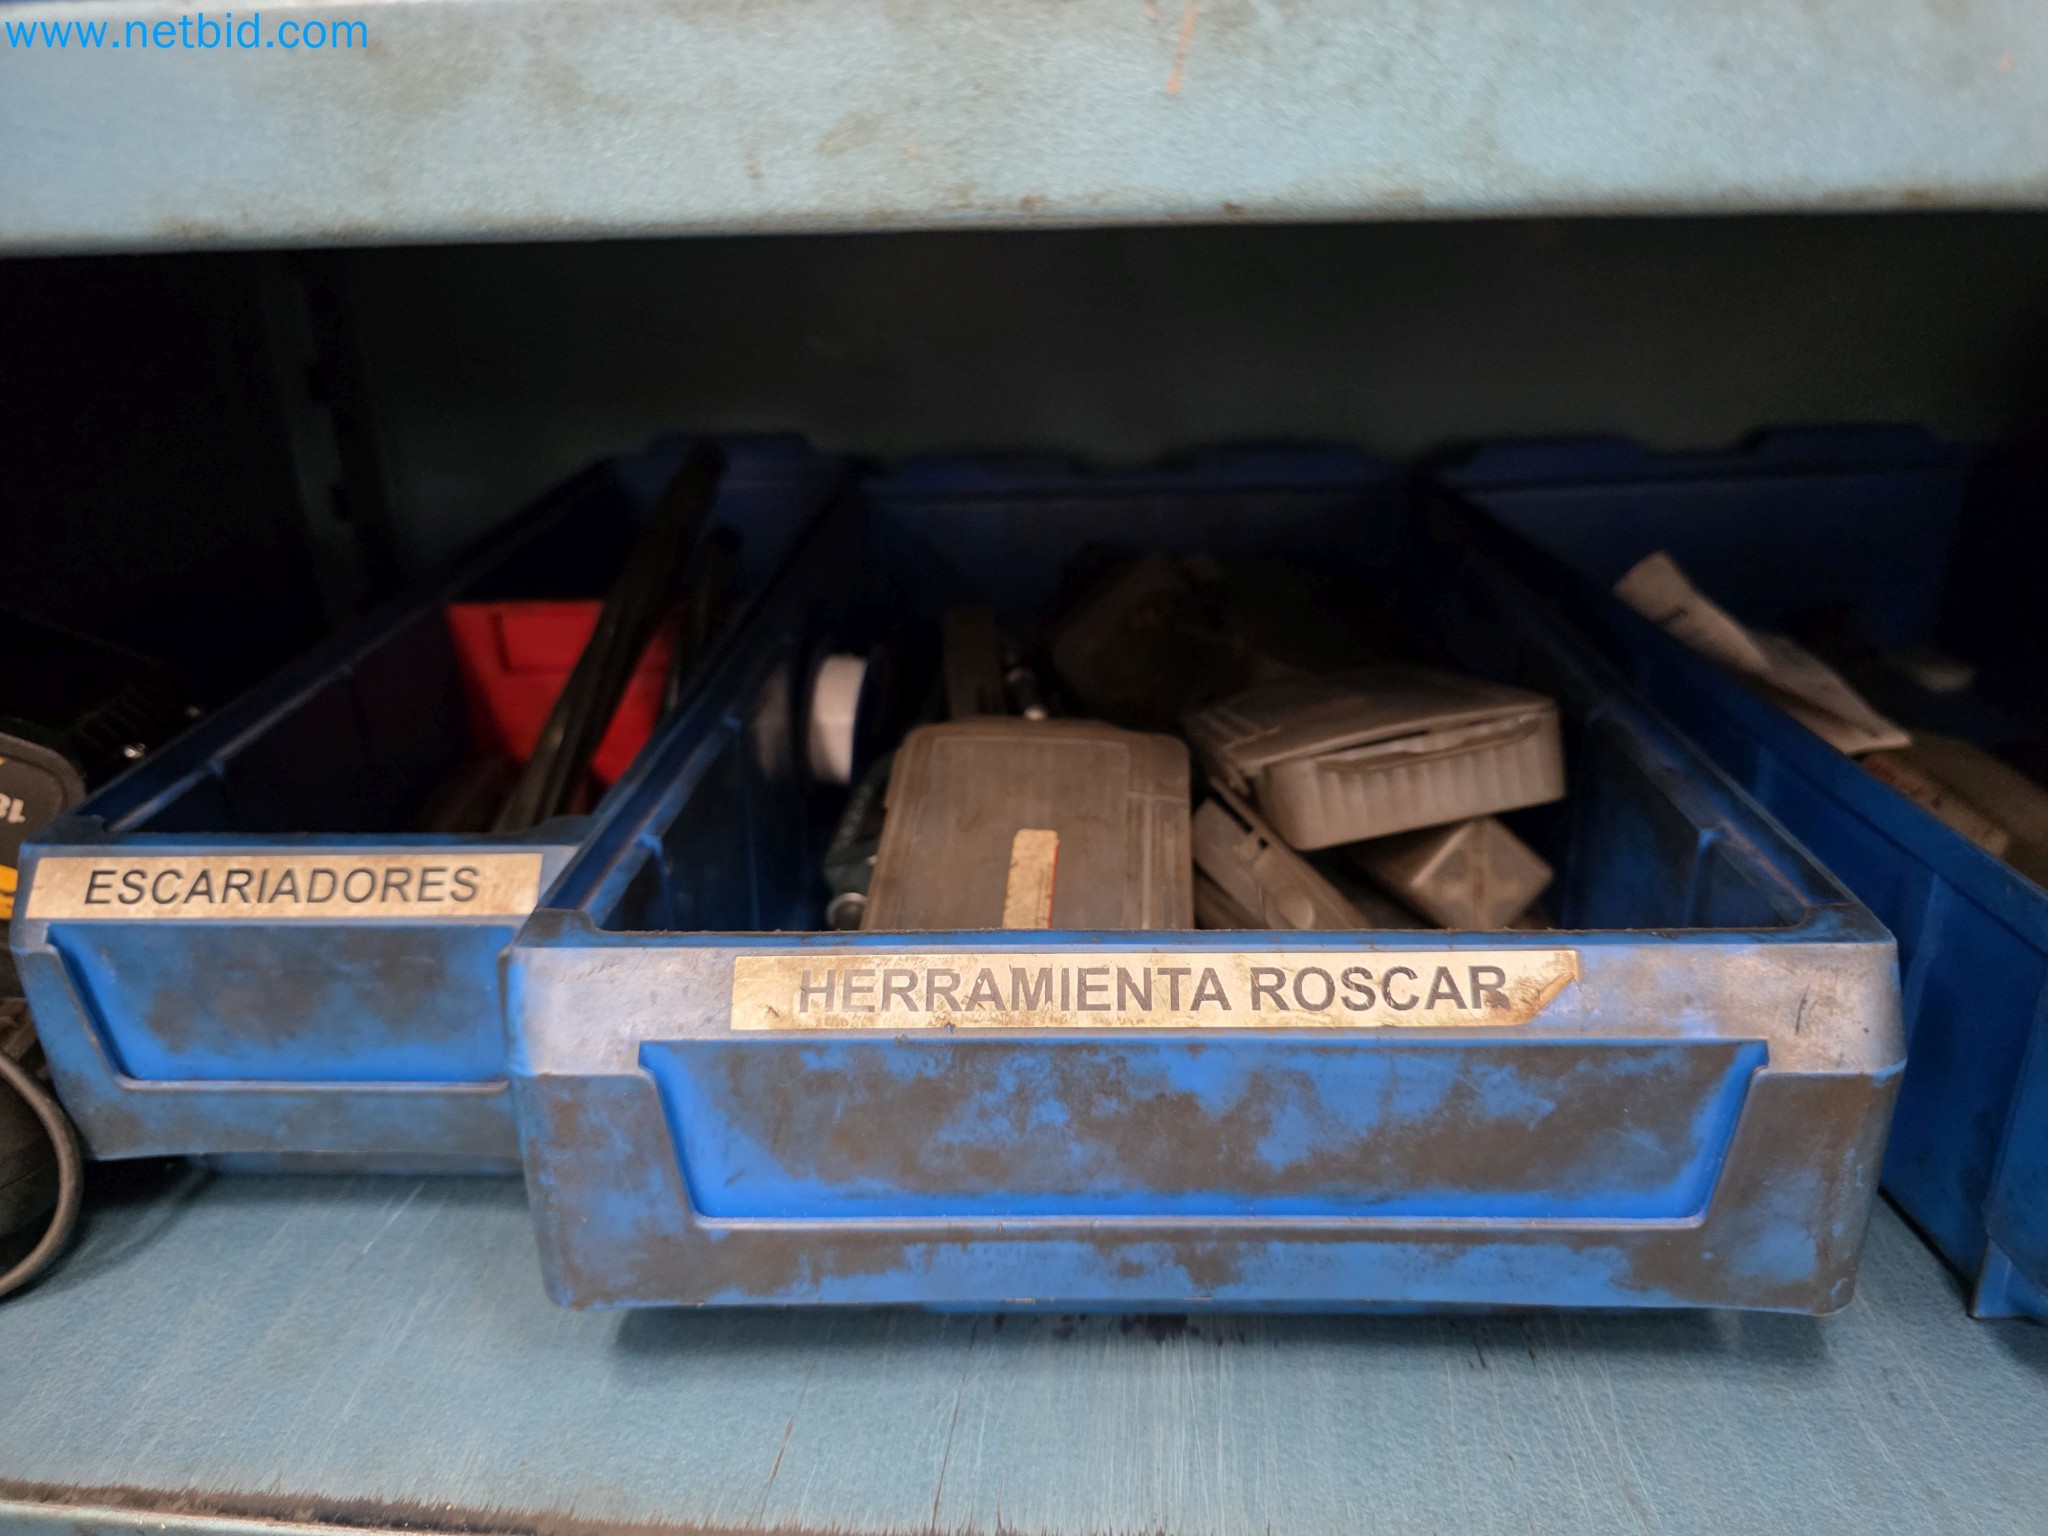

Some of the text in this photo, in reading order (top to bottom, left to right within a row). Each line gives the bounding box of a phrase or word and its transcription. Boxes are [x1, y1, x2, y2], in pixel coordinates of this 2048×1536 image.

[84, 866, 480, 905] ESCARIADORES
[799, 965, 1509, 1014] HERRAMIENTA ROSCAR
